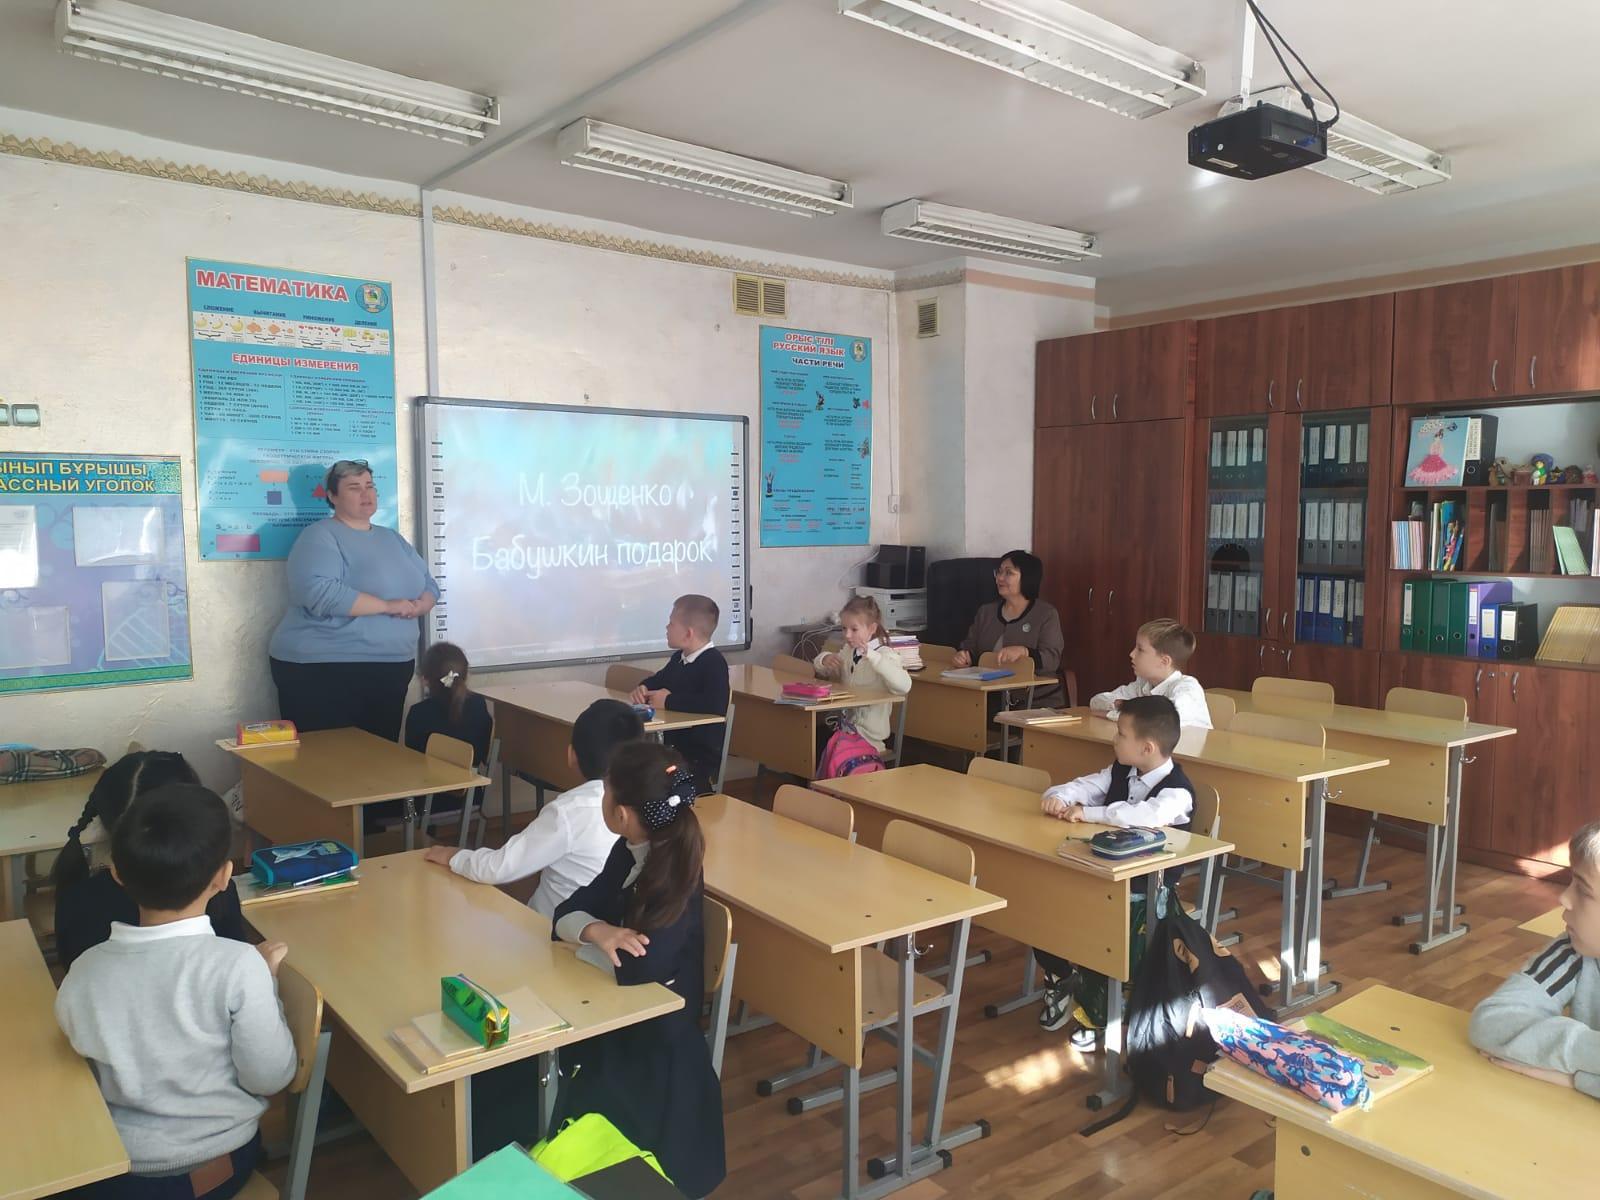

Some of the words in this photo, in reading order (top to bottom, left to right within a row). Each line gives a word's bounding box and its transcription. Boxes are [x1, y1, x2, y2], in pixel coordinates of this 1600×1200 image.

[196, 269, 349, 302] МАТЕМАТИКА
[785, 333, 813, 343] ОРЫС
[816, 336, 834, 345] ТІЛІ
[773, 341, 816, 353] РУССКИЙ
[819, 347, 845, 356] ЯЗЫК
[232, 353, 291, 367] ЕДИНИЦЫ
[294, 358, 360, 372] ИЗМЕРЕНИЯ
[792, 357, 821, 366] ЧАСТИ
[822, 360, 845, 369] РЕЧИ
[59, 462, 148, 476] БҰРЫШЫ
[86, 478, 156, 492] УГОЛОК
[519, 474, 552, 507] М.
[561, 472, 673, 511] Зощенко
[472, 534, 608, 579] Бабушкин
[616, 537, 713, 576] подарок
